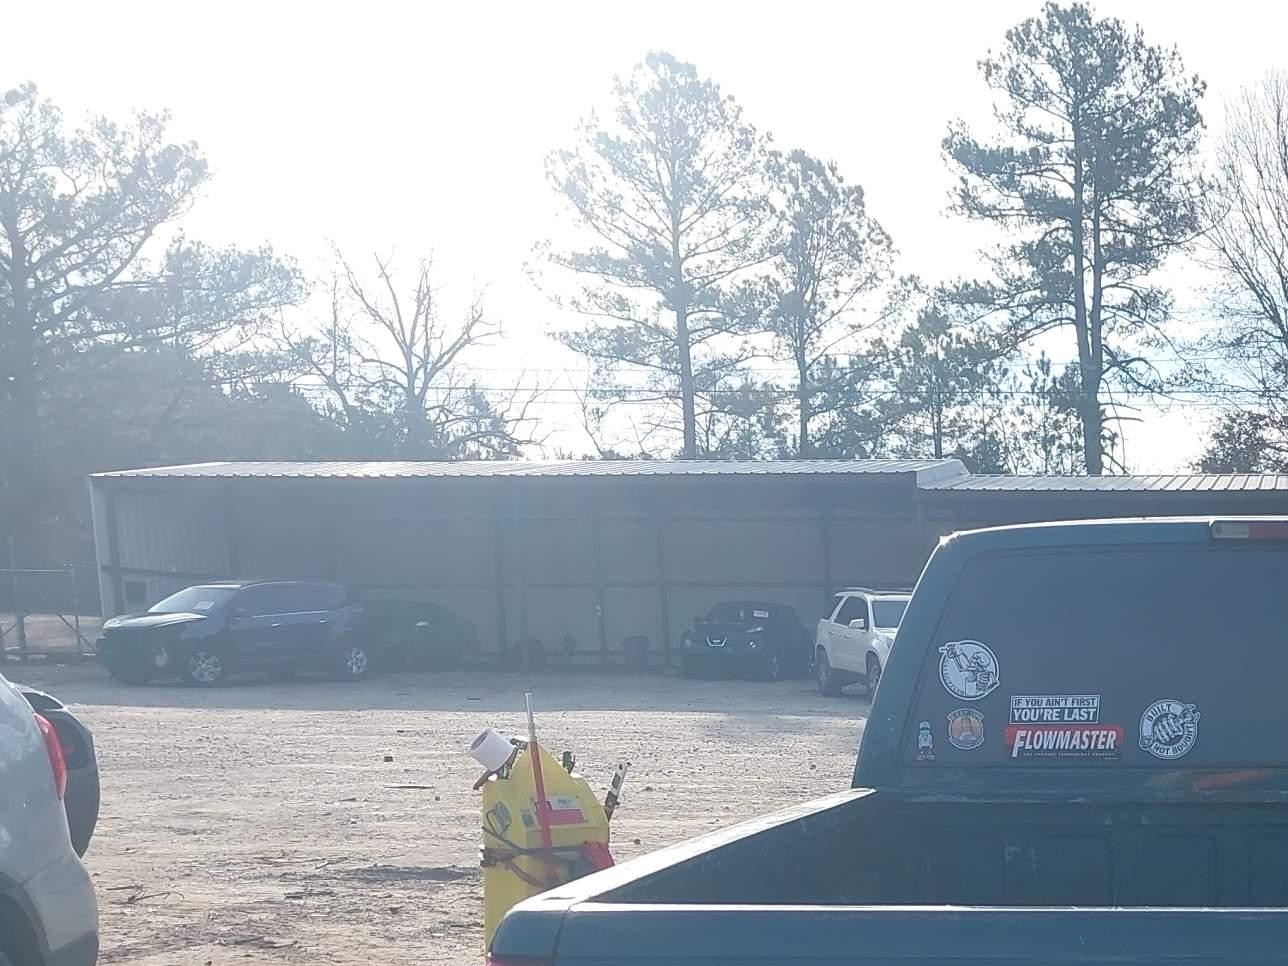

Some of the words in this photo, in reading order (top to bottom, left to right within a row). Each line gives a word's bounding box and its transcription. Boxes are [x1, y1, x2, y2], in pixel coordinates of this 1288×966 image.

[1014, 698, 1022, 706] IF
[1025, 698, 1043, 706] YOU
[1046, 698, 1068, 706] AIN'T
[1071, 697, 1096, 706] FIRST
[1013, 708, 1061, 721] YOU'RE
[1064, 708, 1096, 721] LAST
[1146, 703, 1171, 722] BUILT
[1011, 730, 1117, 758] FLOWMASTER
[1152, 742, 1171, 754] NOT
[1172, 724, 1193, 754] BOUGHT
